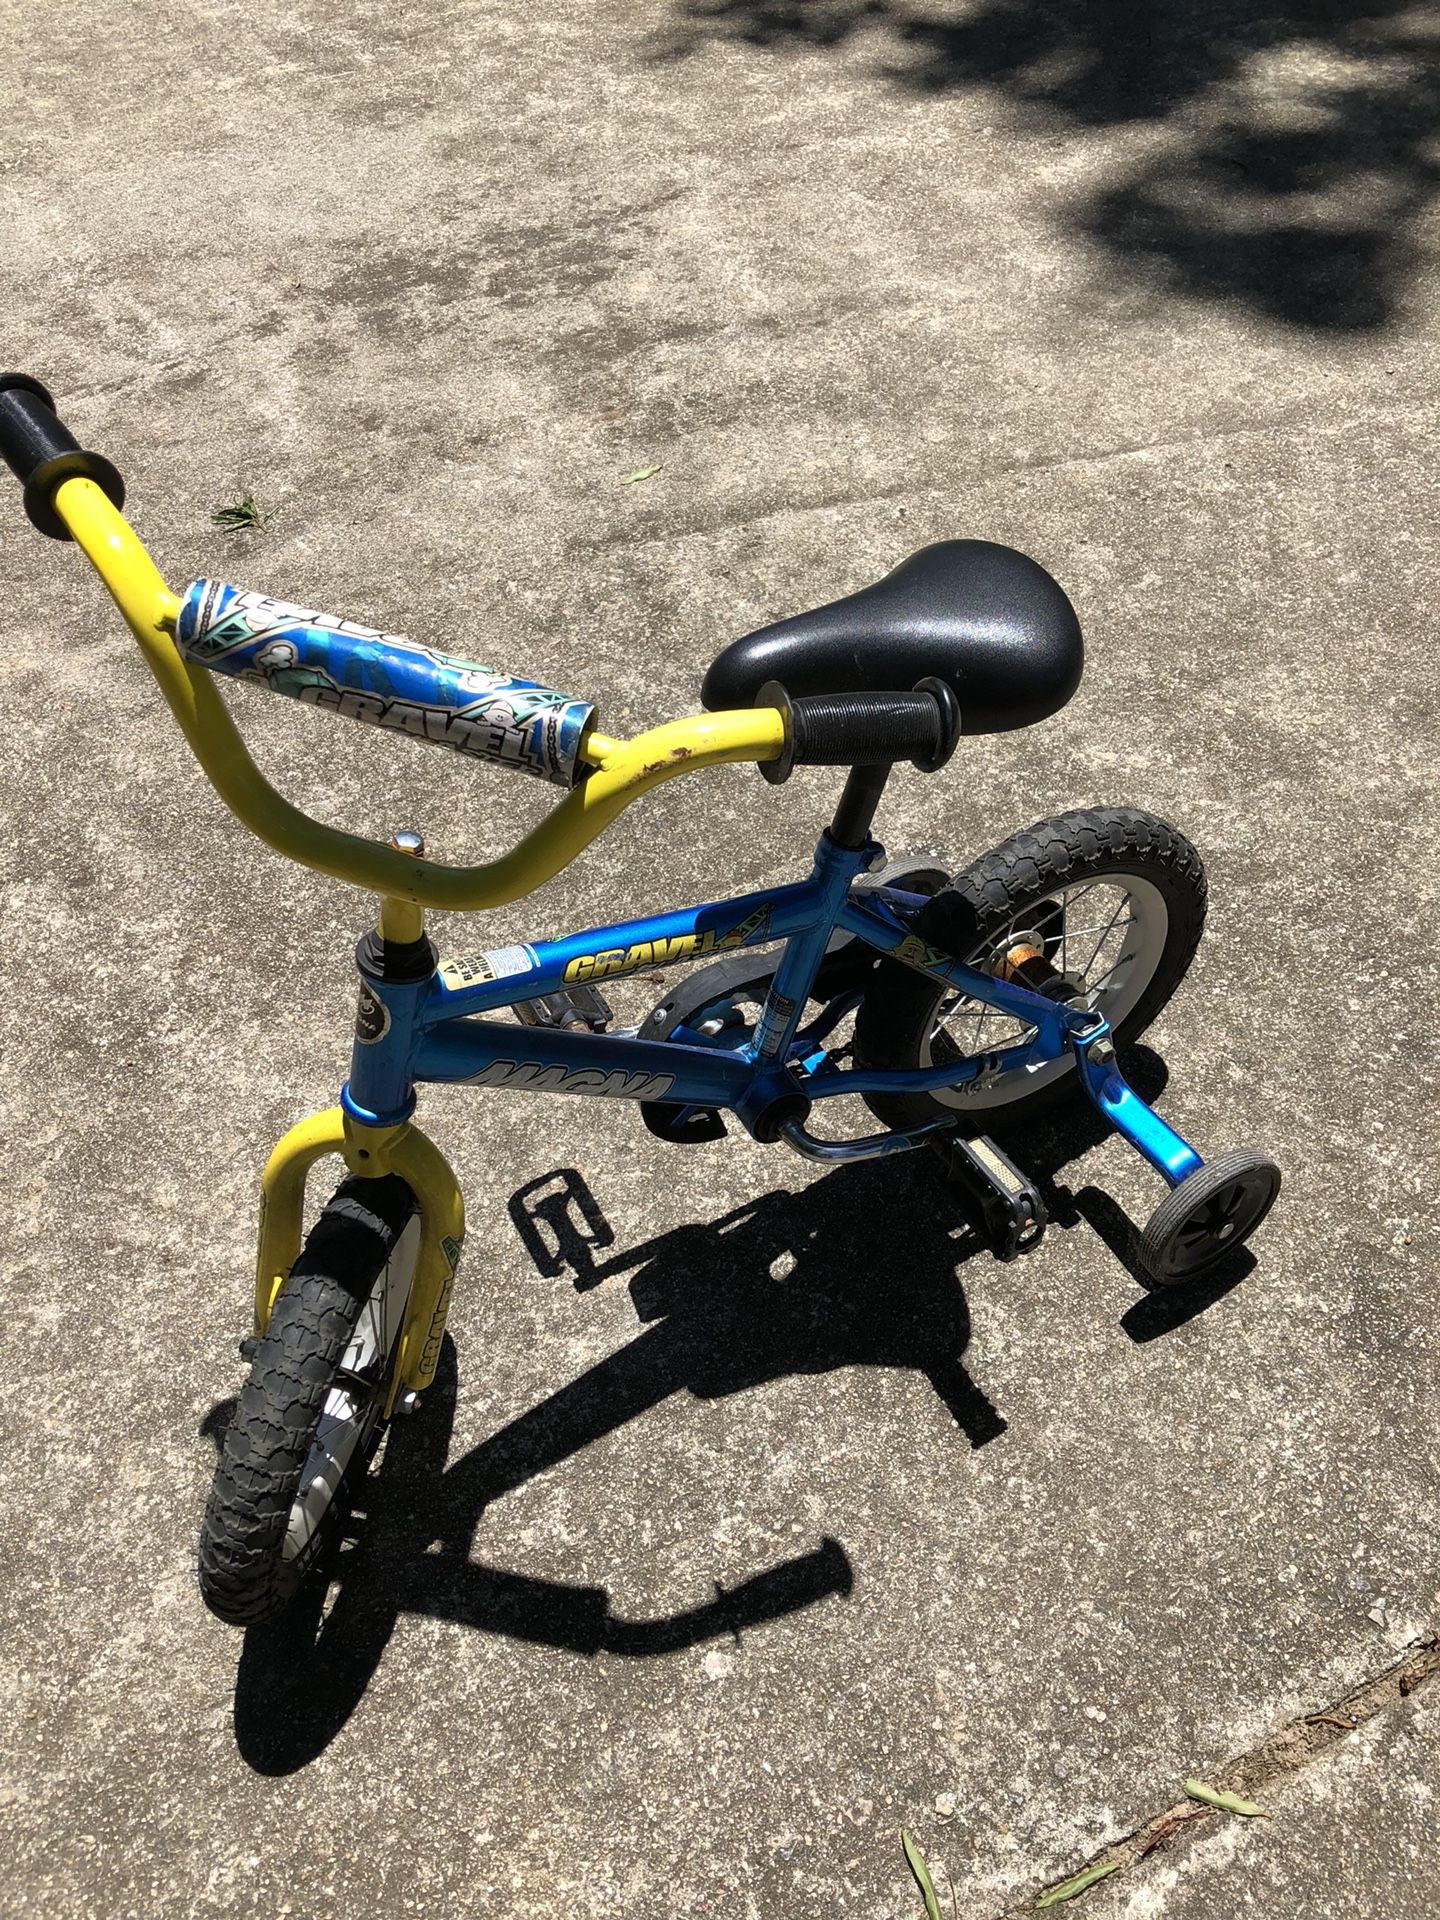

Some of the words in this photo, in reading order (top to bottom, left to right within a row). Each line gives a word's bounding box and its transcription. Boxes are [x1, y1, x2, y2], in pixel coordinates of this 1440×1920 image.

[300, 685, 542, 764] GRAVEL
[461, 969, 473, 981] BE
[562, 929, 720, 983] GRAVEL
[457, 1059, 676, 1100] MAGNA
